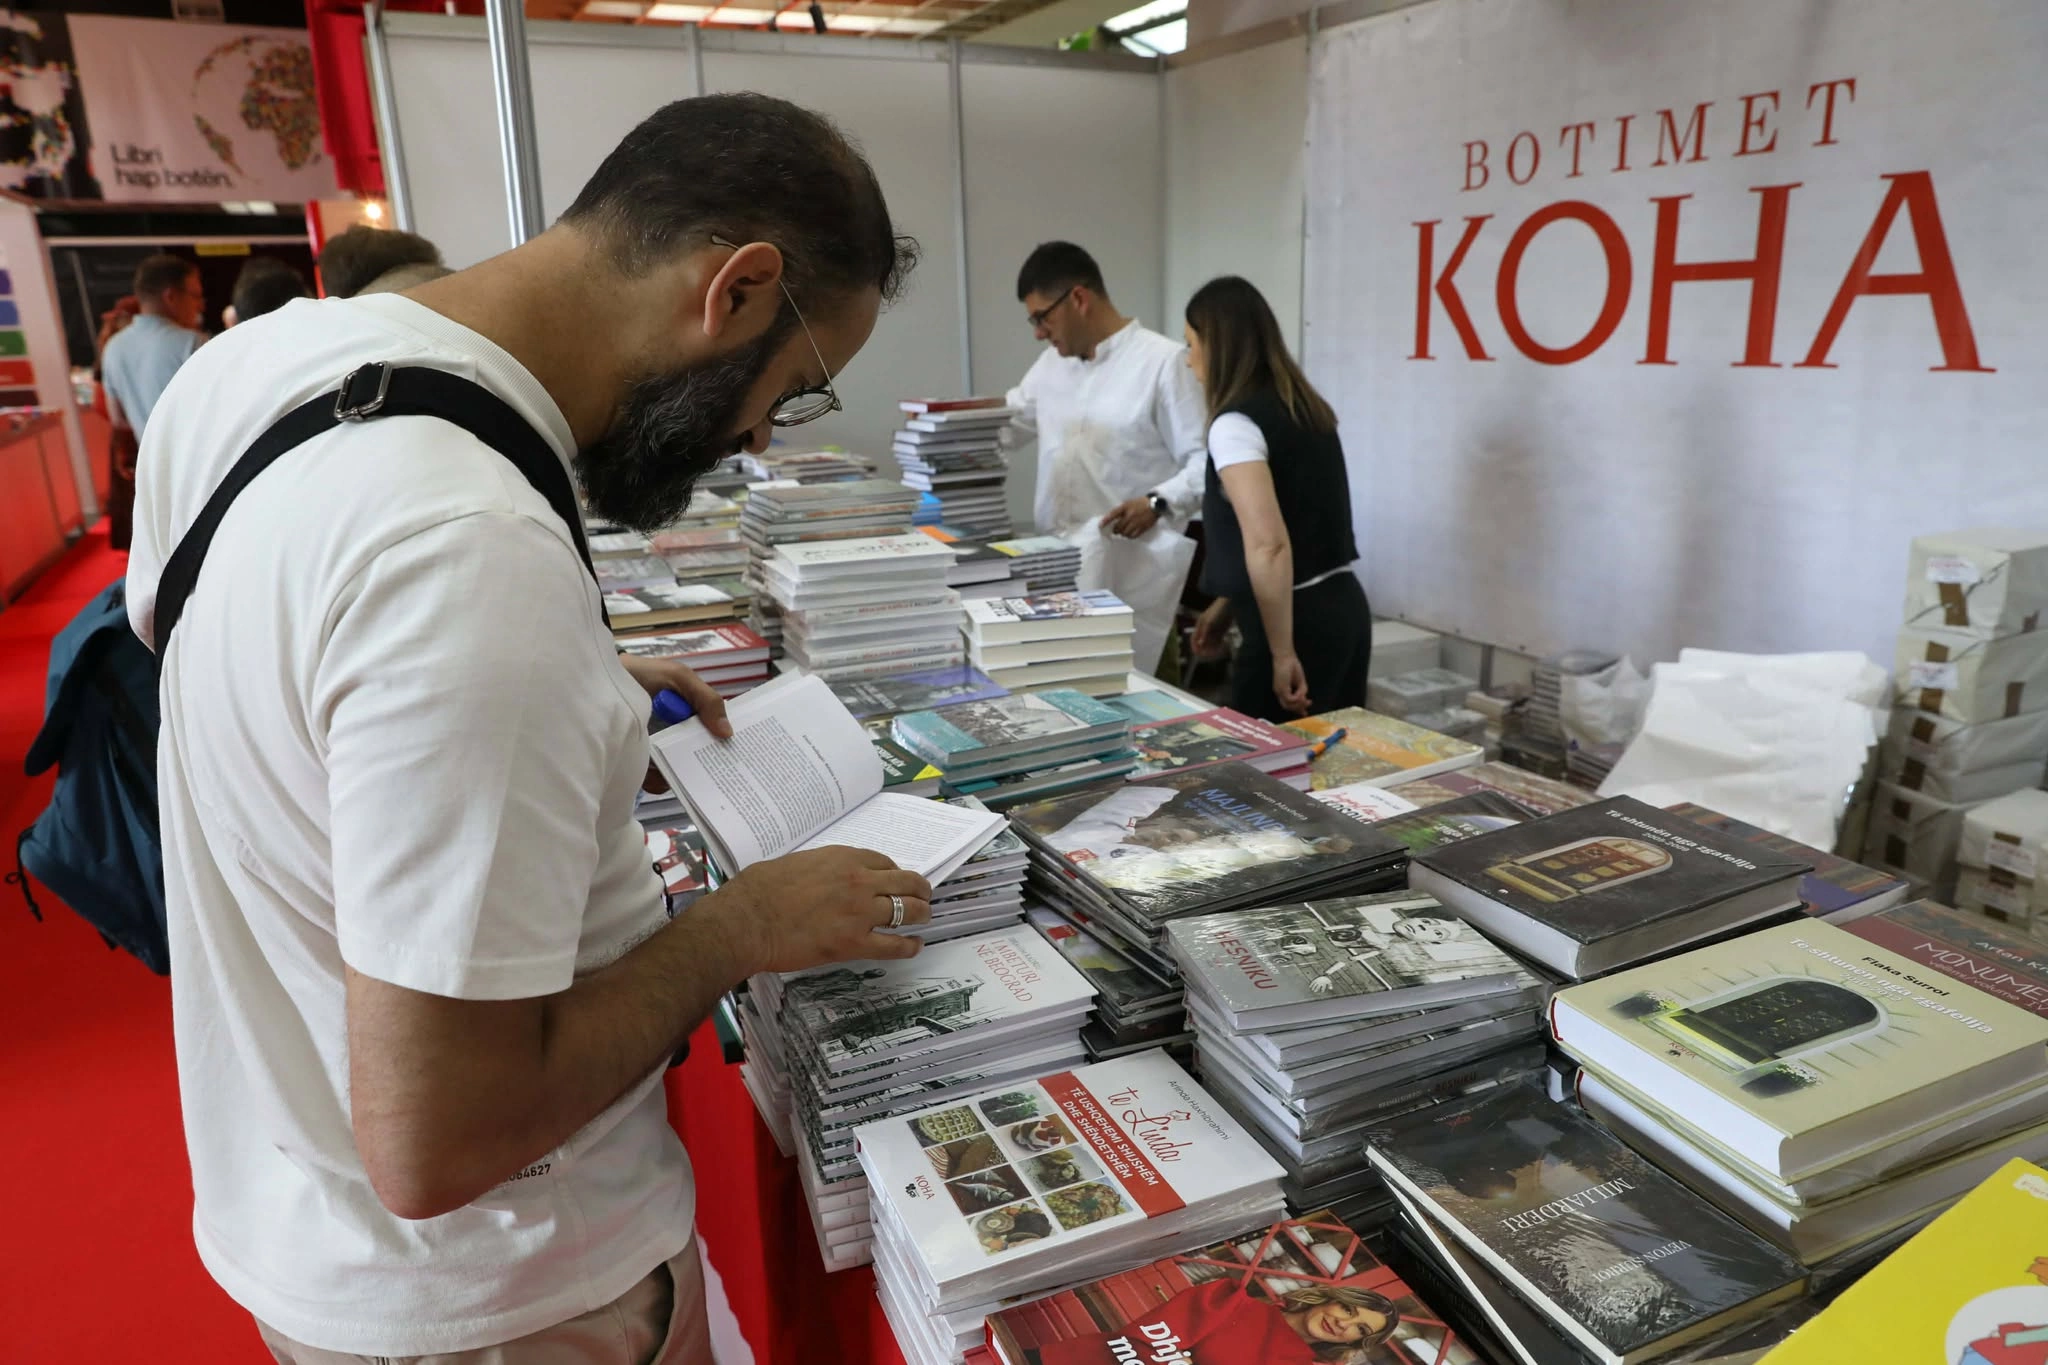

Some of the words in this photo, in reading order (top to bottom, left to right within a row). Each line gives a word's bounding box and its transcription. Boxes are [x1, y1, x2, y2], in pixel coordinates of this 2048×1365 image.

[110, 143, 162, 163] Libri
[1459, 77, 1857, 192] BOTIMET
[114, 167, 160, 190] hap
[1407, 170, 1997, 374] KOHA
[1605, 809, 1622, 818] Të
[1620, 815, 1672, 839] shtunën
[1671, 834, 1698, 848] nga
[1697, 845, 1757, 870] zgafellja
[995, 943, 1041, 984] MBETURI
[1975, 941, 2024, 962] Artan
[984, 957, 1033, 1002] BEOGRAD
[1808, 948, 1879, 980] shtunën
[1877, 978, 1912, 997] nga
[1911, 994, 1993, 1034] zgafellja
[1861, 956, 1901, 976] Flaka
[1903, 974, 1951, 997] Surroi
[1107, 1086, 1139, 1106] te
[1168, 1080, 1192, 1102] Arlinda
[1063, 1101, 1080, 1118] DHE
[1077, 1117, 1133, 1179] SHËNDETSHËM
[1070, 1087, 1084, 1098] TË
[1079, 1095, 1123, 1144] USHQEHEMI
[1117, 1143, 1159, 1186] SHIJSHËM
[1122, 1108, 1193, 1162] Linda
[914, 1175, 935, 1200] KOHA
[1500, 1177, 1636, 1233] MILIARDERI
[1593, 1256, 1647, 1283] SURROI
[1645, 1239, 1692, 1263] VETON
